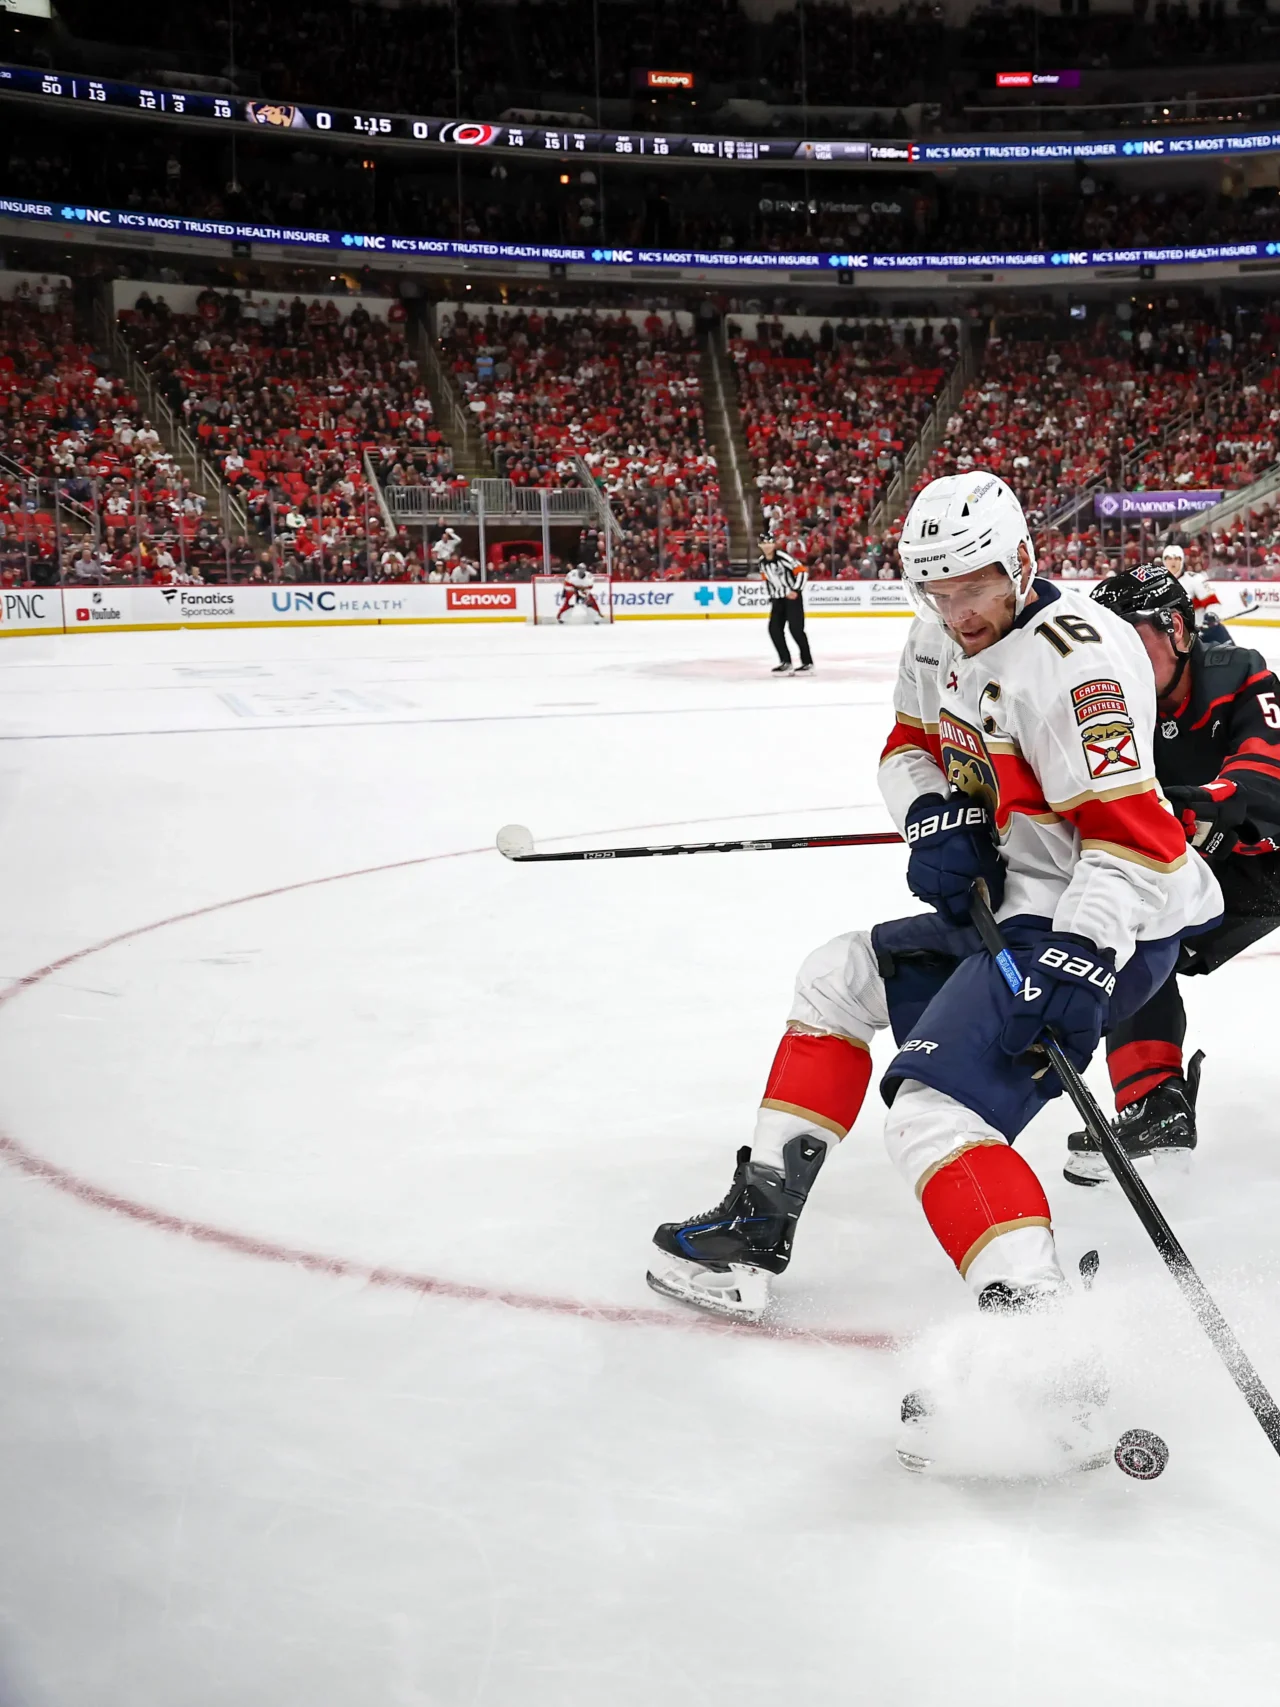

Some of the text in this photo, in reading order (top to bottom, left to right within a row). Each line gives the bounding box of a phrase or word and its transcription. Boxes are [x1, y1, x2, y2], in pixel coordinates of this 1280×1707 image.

[652, 73, 690, 86] Lenovo
[41, 81, 62, 95] 50
[88, 88, 106, 102] 13
[139, 96, 156, 109] 12
[174, 101, 185, 113] 3
[214, 105, 232, 118] 19
[316, 112, 332, 130] 0
[353, 115, 392, 133] 1:15
[413, 122, 428, 139] 0
[508, 134, 524, 147] 14
[544, 137, 560, 150] 15
[575, 140, 585, 151] 4
[615, 141, 633, 153] 36
[1169, 140, 1194, 151] NC'S
[1194, 139, 1225, 149] MOST
[1225, 136, 1272, 148] TRUSTED
[653, 144, 669, 155] 18
[691, 142, 715, 154] TOI
[925, 148, 951, 158] NC'S
[950, 147, 982, 157] MOST
[982, 147, 1030, 157] TRUSTED
[1031, 146, 1072, 156] HEALTH
[1073, 144, 1117, 155] INSURER
[1142, 141, 1165, 154] NC
[0, 201, 53, 215] INSURER
[86, 210, 111, 223] NC
[118, 214, 330, 242] NC'S MOST TRUSTED HEALTH INSURER
[363, 236, 386, 249] NC
[391, 240, 586, 259] NC'S MOST TRUSTED HEALTH INSURER
[611, 250, 634, 262] NC
[1092, 245, 1257, 261] NC'S MOST TRUSTED HEALTH INSURER
[638, 253, 820, 265] NC'S MOST TRUSTED HEALTH INSURER
[847, 255, 869, 267] NC
[873, 255, 1045, 265] NC'S MOST TRUSTED HEALTH INSURER
[1067, 252, 1088, 264] NC
[920, 518, 939, 538] 16
[913, 553, 947, 564] BAUER
[180, 592, 235, 605] Fanatics
[271, 591, 403, 612] UNC HEALTH
[451, 591, 511, 606] Lenovo
[4, 594, 46, 619] PNC
[180, 606, 236, 617] Sportsbook
[90, 608, 121, 620] YouTube
[1034, 614, 1102, 659] 16
[1078, 683, 1117, 698] CAPTAIN
[979, 680, 1001, 734] C
[1082, 700, 1122, 717] PANTHERS
[1208, 831, 1225, 854] CCM
